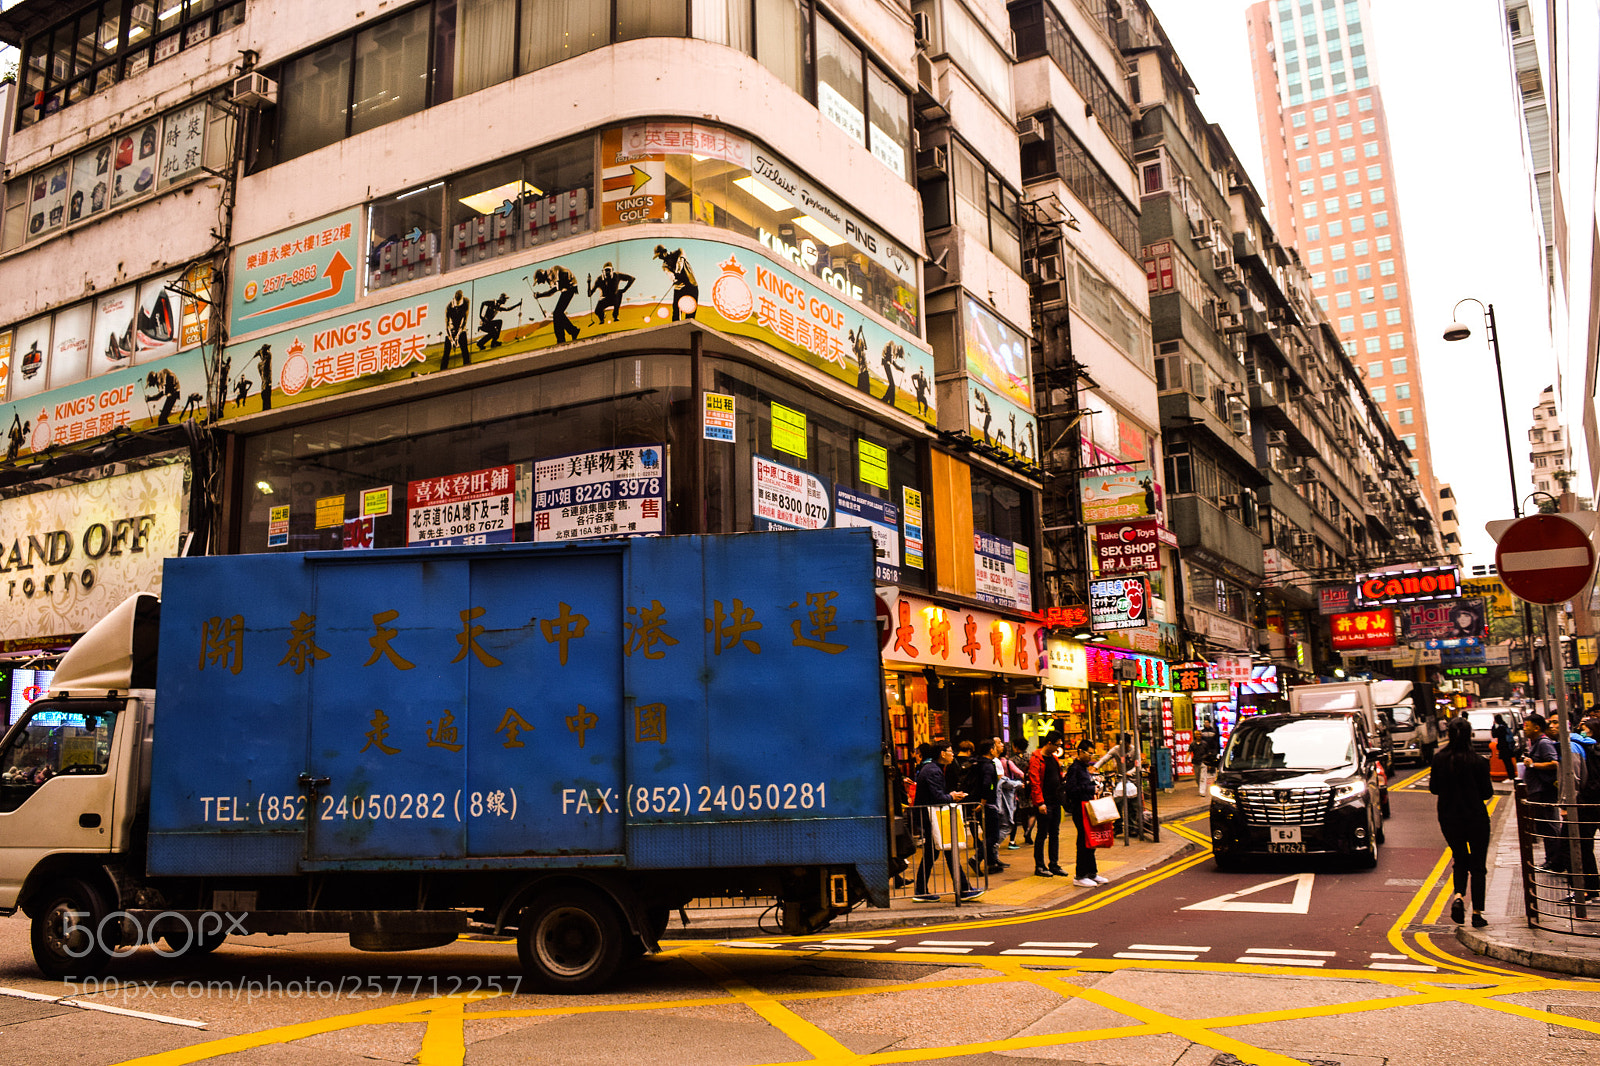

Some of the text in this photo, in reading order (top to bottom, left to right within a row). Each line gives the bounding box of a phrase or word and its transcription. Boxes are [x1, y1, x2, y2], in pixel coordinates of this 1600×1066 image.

[645, 130, 732, 154] 英皇高爾夫
[616, 196, 655, 212] KING'S
[619, 208, 650, 222] GOLF
[753, 154, 797, 197] Titleist
[845, 219, 877, 254] PING
[246, 222, 352, 271] 樂道永樂大樓1至2樓
[262, 265, 318, 294] 2577-8863
[756, 265, 845, 332] KING'S GOLF
[312, 305, 429, 353] KING'S GOLF
[758, 296, 846, 370] 英皇高爾夫
[311, 334, 427, 388] 英皇高爾夫
[54, 383, 135, 421] KING'S GOLF
[713, 397, 733, 411] 出租
[54, 408, 131, 445] 英皇高爾夫
[567, 449, 634, 478] 美華物業
[415, 468, 509, 502] 喜來登旺鋪
[535, 477, 660, 508] 周小姐 8226 3978
[413, 496, 510, 529] 北京道16A地下及一樓
[577, 512, 615, 526] 各行各業
[640, 498, 660, 519] 售
[779, 494, 802, 514] 8300
[805, 502, 828, 521] 0270
[1084, 504, 1140, 521] 英皇高爾夫
[450, 524, 476, 536] 9018
[478, 519, 504, 532] 7672
[535, 512, 551, 531] 租
[1099, 529, 1155, 541] Take Toys
[83, 514, 156, 560] OFF
[1101, 542, 1156, 557] SEX SHOP
[882, 566, 898, 582] 5618
[1102, 555, 1158, 572] 成人用品
[8, 568, 95, 601] TOKYO
[1321, 588, 1349, 600] Hair
[1362, 573, 1456, 599] Canon
[1337, 614, 1386, 632] 許留山
[1410, 604, 1452, 624] Hair
[199, 591, 849, 675] 開泰天天中港快運
[1349, 633, 1366, 641] LAU
[359, 703, 667, 756] 走遍全中國
[200, 796, 250, 822] TEL:
[321, 793, 445, 821] 24050282
[562, 782, 827, 817] FAX: (852) 24050281
[1278, 830, 1294, 839] EJ
